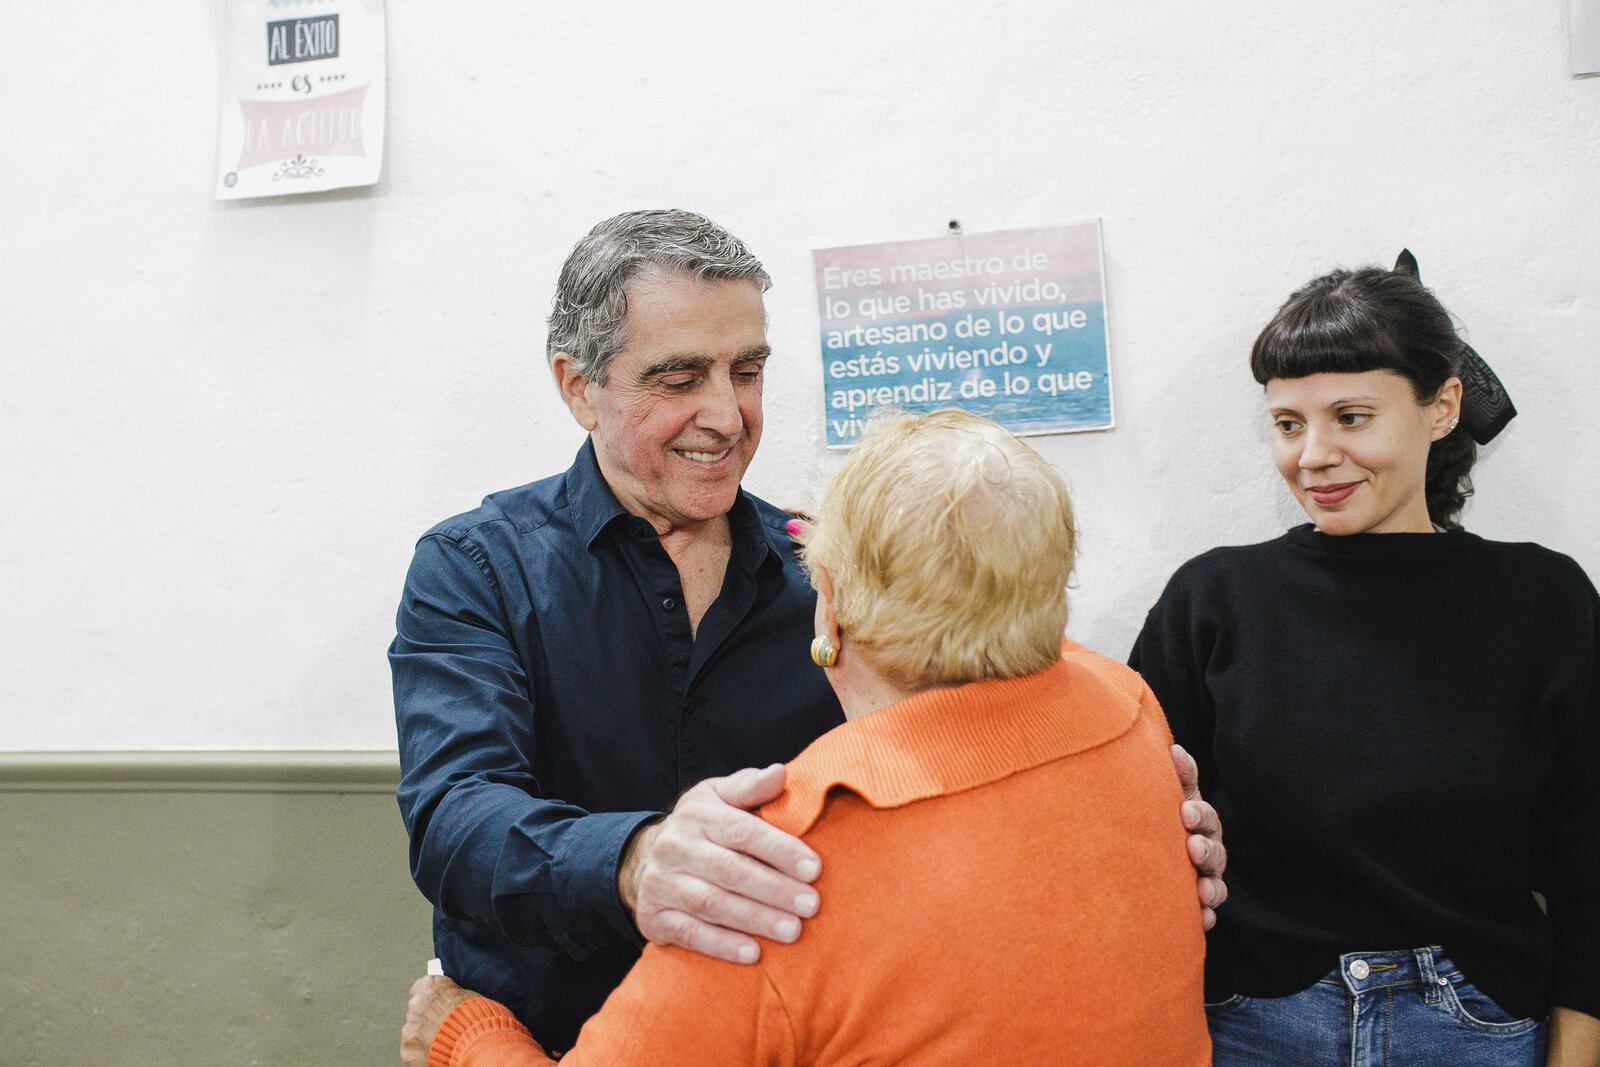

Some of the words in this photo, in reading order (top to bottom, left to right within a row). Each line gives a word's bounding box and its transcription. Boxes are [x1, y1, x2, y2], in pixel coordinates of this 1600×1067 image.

[270, 25, 290, 61] AL
[294, 20, 337, 59] ÉXITO
[291, 74, 312, 94] es
[245, 117, 270, 152] LA
[281, 107, 360, 148] ACTITUD
[823, 266, 883, 290] Eres
[890, 254, 1004, 283] maestro
[1012, 248, 1049, 272] de
[825, 296, 851, 319] lo
[858, 295, 911, 320] que
[918, 288, 966, 312] has
[973, 278, 1067, 307] vivido,
[827, 322, 947, 349] artesano
[955, 314, 991, 339] de
[998, 311, 1025, 335] lo
[1032, 309, 1087, 335] que
[829, 351, 900, 379] estás
[907, 341, 1028, 373] viviendo
[1035, 343, 1053, 367] y
[831, 378, 952, 411] aprendiz
[959, 375, 996, 399] de
[1004, 371, 1030, 395] lo
[1037, 369, 1092, 396] que
[832, 413, 876, 438] viv
